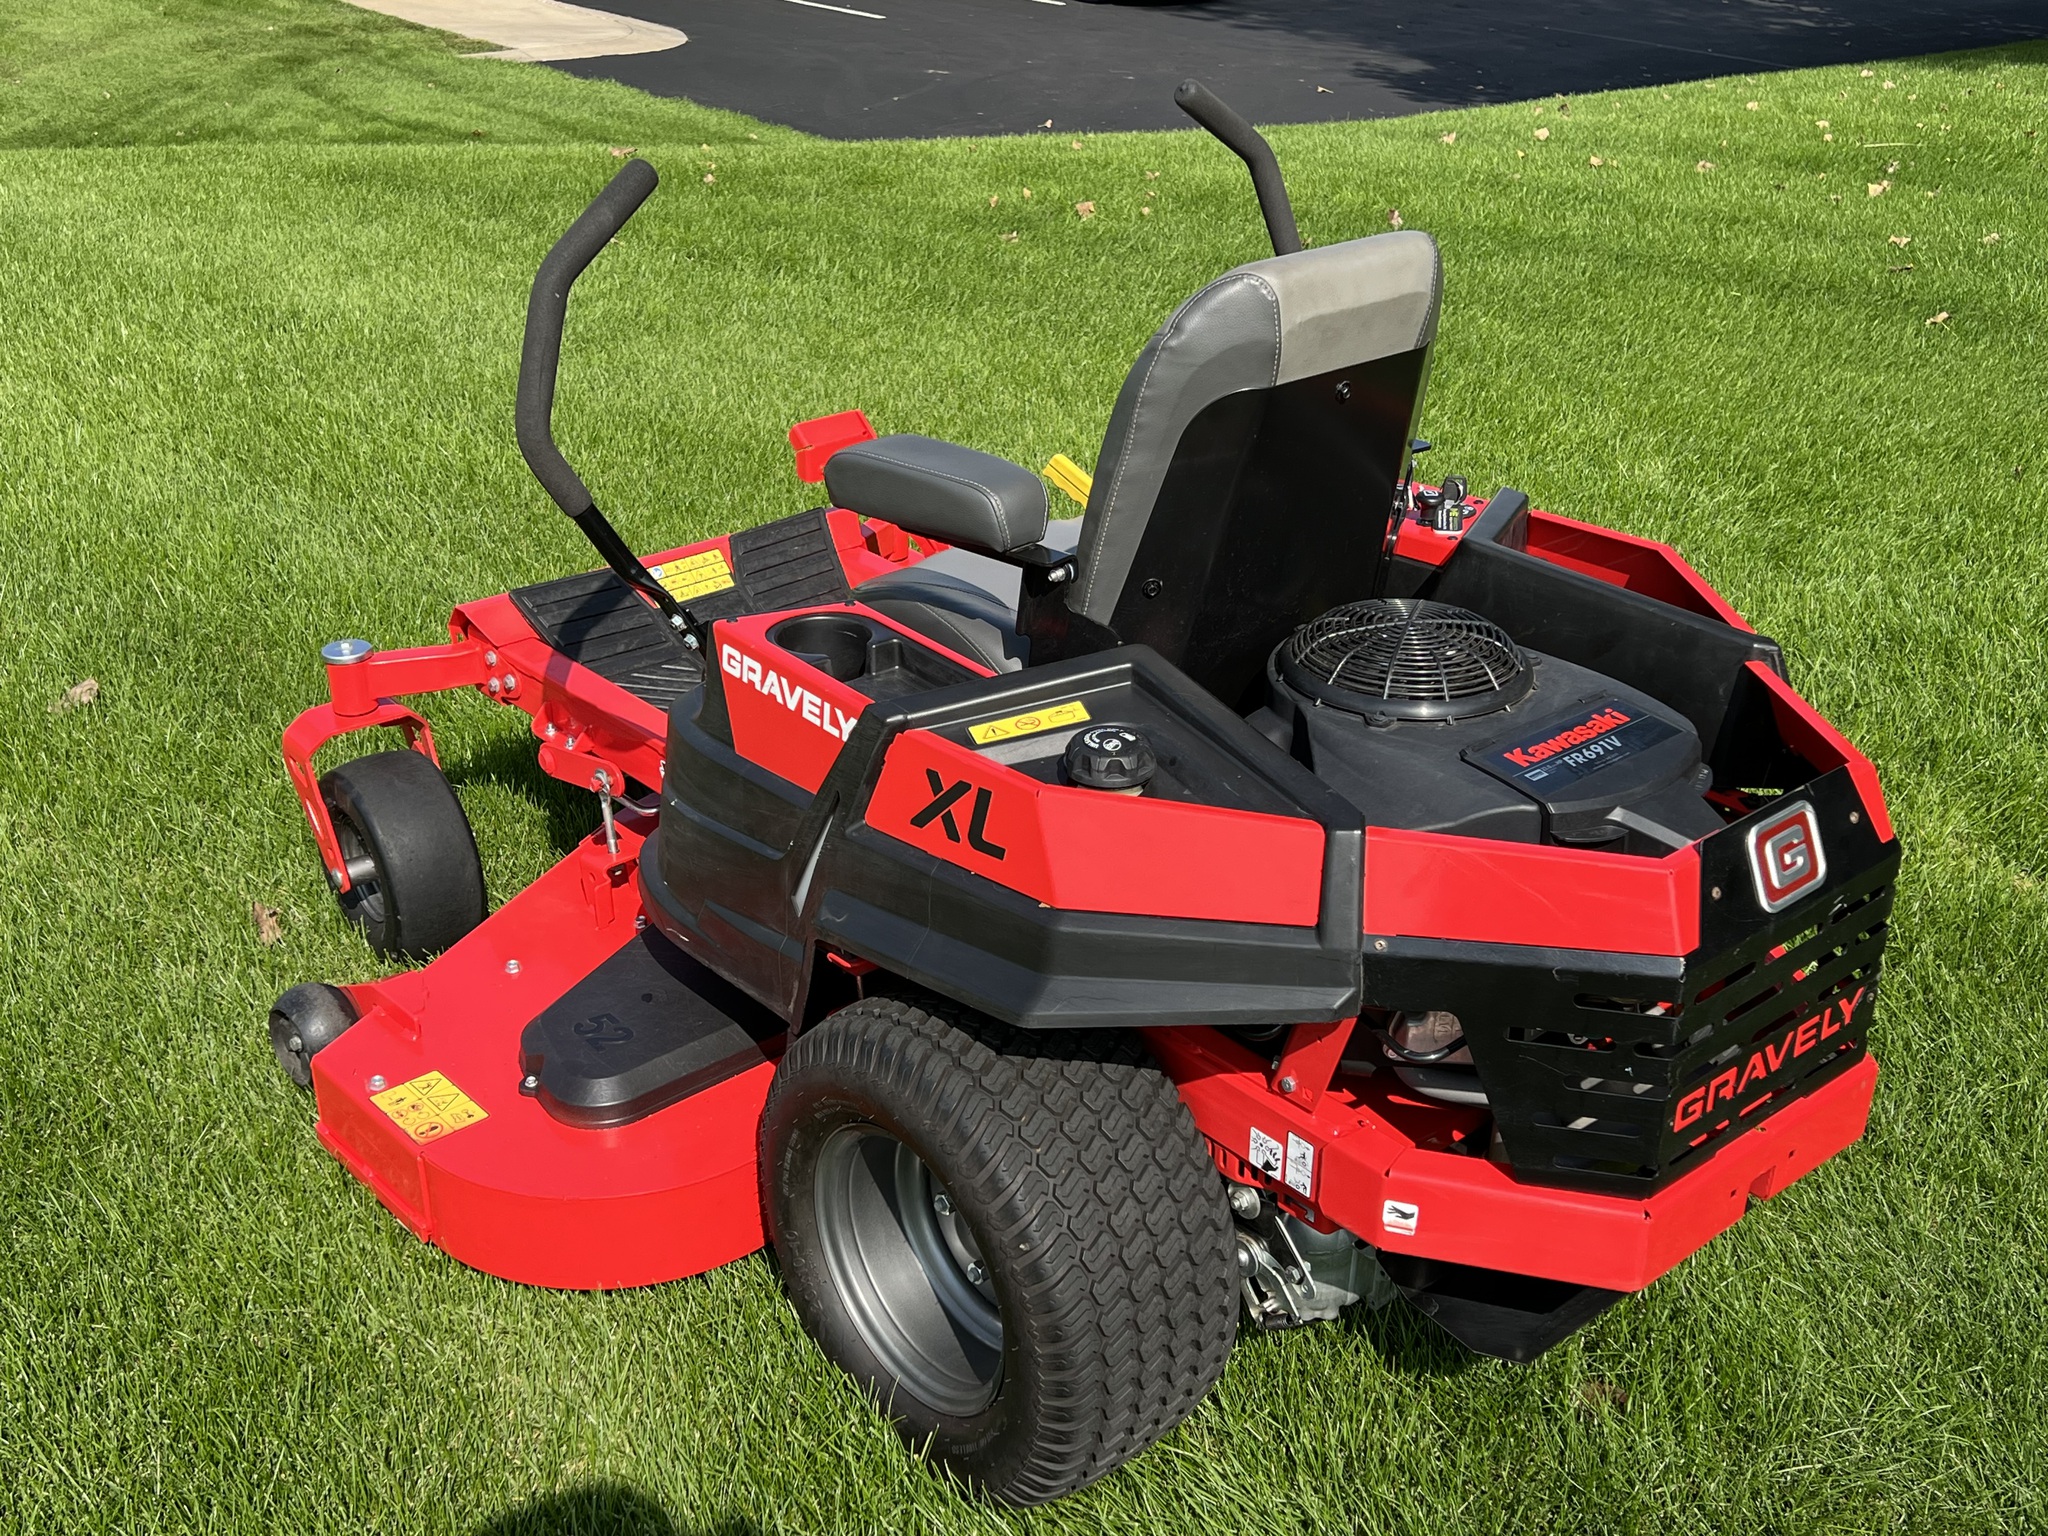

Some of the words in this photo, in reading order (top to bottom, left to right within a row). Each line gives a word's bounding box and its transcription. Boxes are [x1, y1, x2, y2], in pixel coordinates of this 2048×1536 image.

[722, 643, 859, 742] GRAVELY
[1503, 708, 1631, 768] Kawasaki
[1562, 735, 1623, 767] FR691V
[910, 767, 1007, 861] XL
[573, 1012, 634, 1051] 52
[1673, 986, 1866, 1133] GRAVELY
